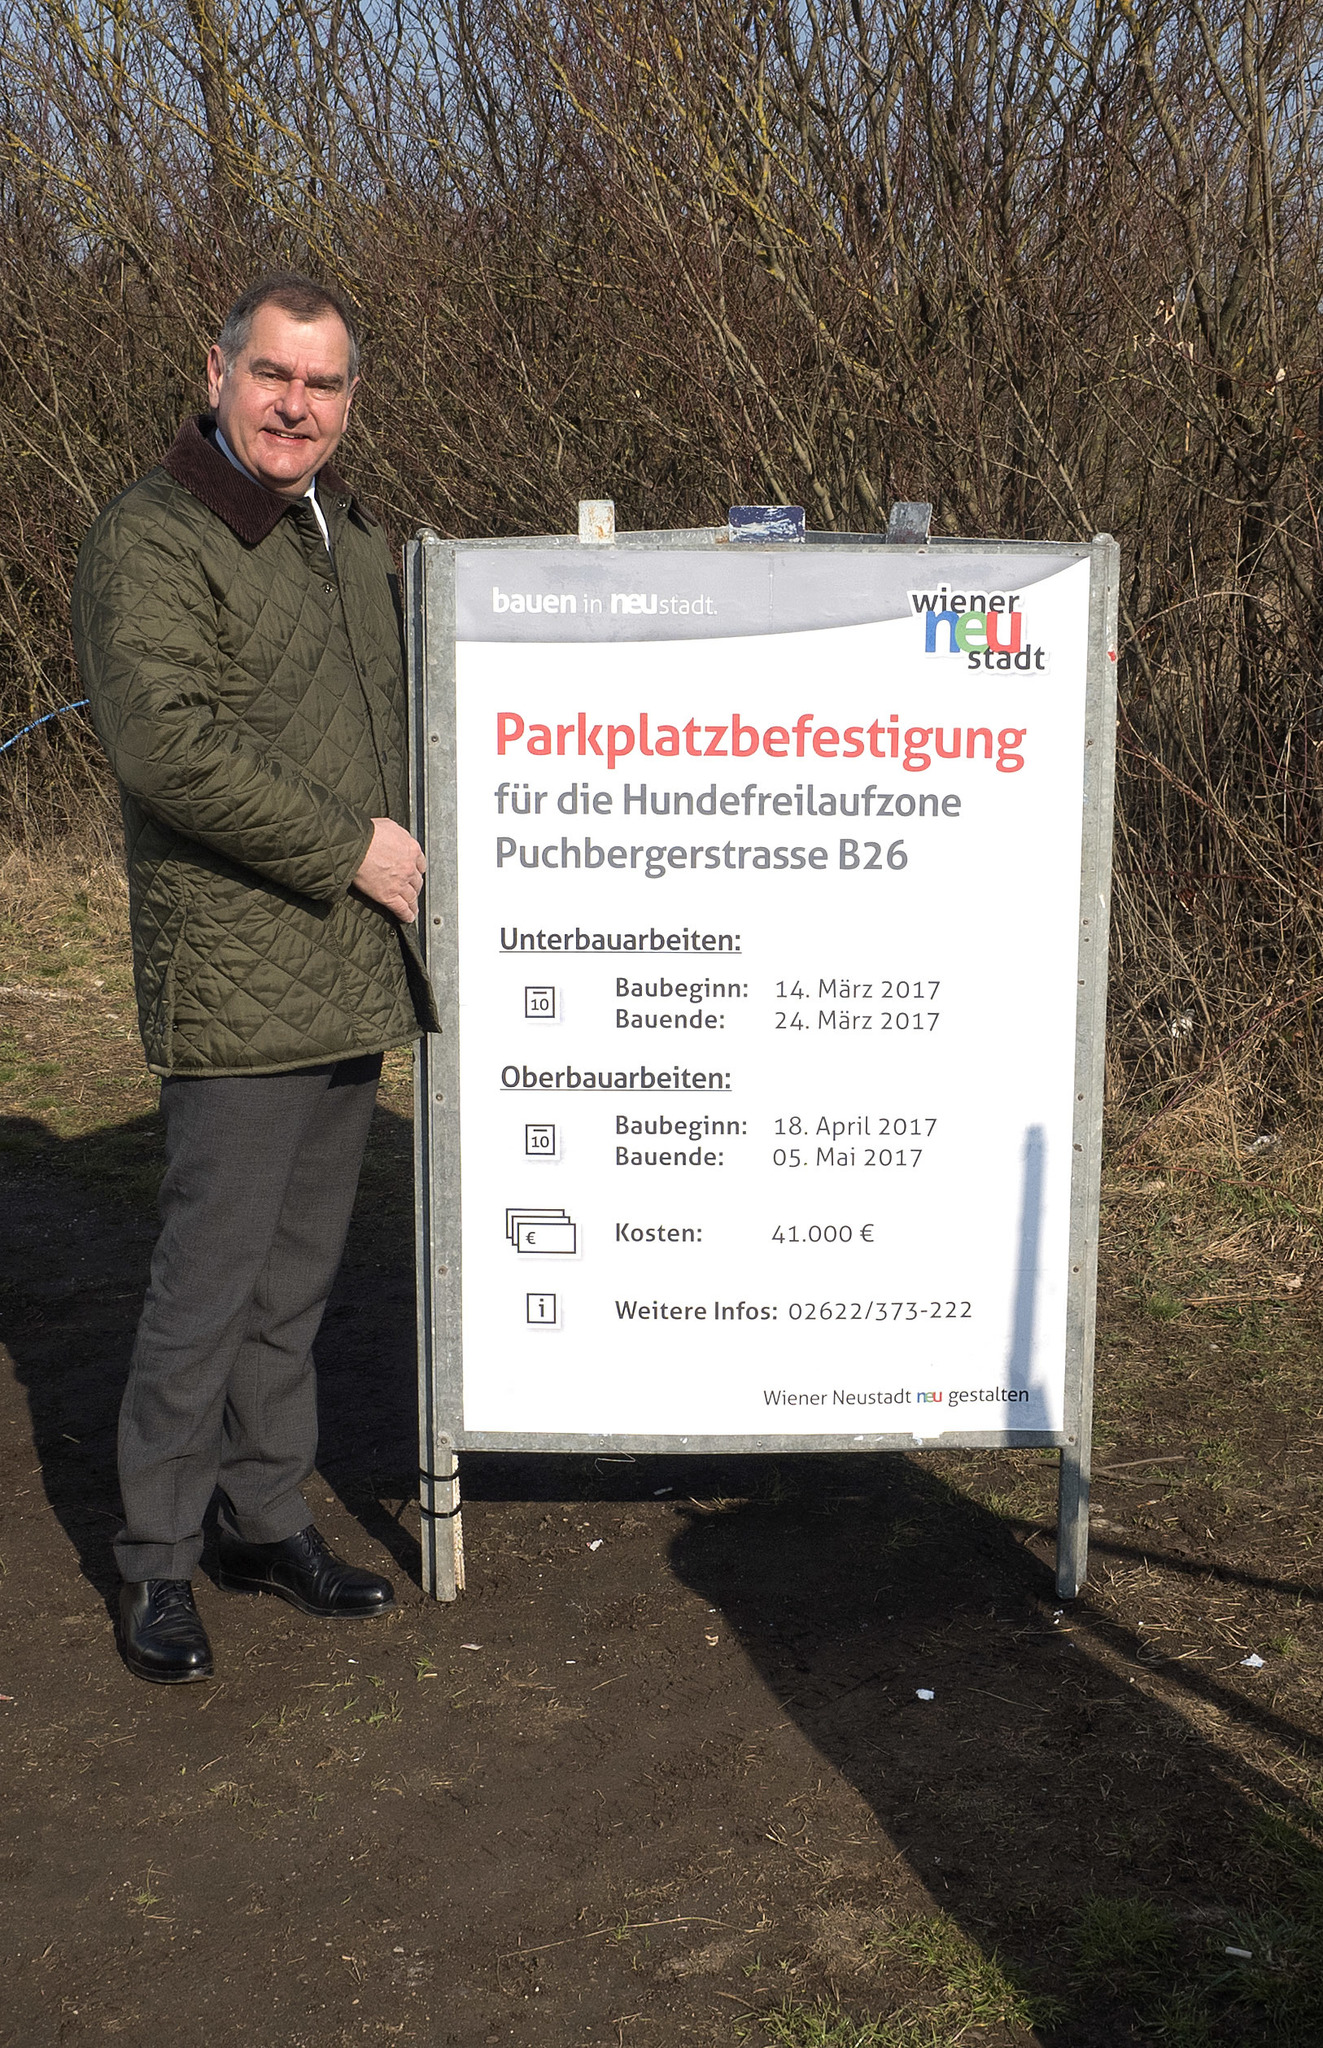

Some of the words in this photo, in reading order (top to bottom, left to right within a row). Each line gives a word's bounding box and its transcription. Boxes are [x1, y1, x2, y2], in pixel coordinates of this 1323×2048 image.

[492, 586, 576, 615] bauen
[583, 592, 604, 614] in
[911, 586, 1020, 614] wiener
[925, 611, 1022, 653] neu
[968, 644, 1046, 670] stadt
[496, 711, 1027, 774] Parkplatzbefestigung
[494, 782, 548, 815] für
[557, 782, 613, 815] die
[623, 783, 962, 818] Hundefreilaufzone
[496, 836, 829, 879] Puchbergerstrasse
[839, 838, 908, 871] B26
[499, 926, 741, 952] Unterbauarbeiten:
[616, 977, 748, 1004] Baubeginn:
[776, 980, 810, 1000] 14.
[818, 978, 873, 999] März
[881, 980, 941, 1001] 2017
[530, 997, 550, 1011] 10
[616, 1008, 725, 1029] Bauende:
[775, 1011, 810, 1031] 24.
[818, 1009, 873, 1030] März
[880, 1011, 940, 1032] 2017
[501, 1064, 731, 1089] Oberbauarbeiten:
[615, 1114, 747, 1142] Baubeginn:
[774, 1115, 808, 1136] 18.
[815, 1115, 871, 1142] April
[878, 1117, 938, 1137] 2017
[531, 1135, 550, 1149] 10
[615, 1146, 724, 1166] Bauende:
[772, 1148, 808, 1168] 05.
[816, 1146, 855, 1167] Mai
[864, 1148, 923, 1168] 2017
[525, 1231, 536, 1245] €
[615, 1222, 702, 1243] Kosten:
[771, 1224, 853, 1244] 41.000
[859, 1223, 875, 1243] €
[614, 1300, 707, 1321] Weitere
[714, 1300, 778, 1321] Infos:
[788, 1300, 972, 1322] 02622/373-222
[763, 1390, 828, 1406] Wiener
[832, 1387, 912, 1406] Neustadt
[916, 1391, 943, 1404] neu
[948, 1384, 1029, 1407] gestalten
